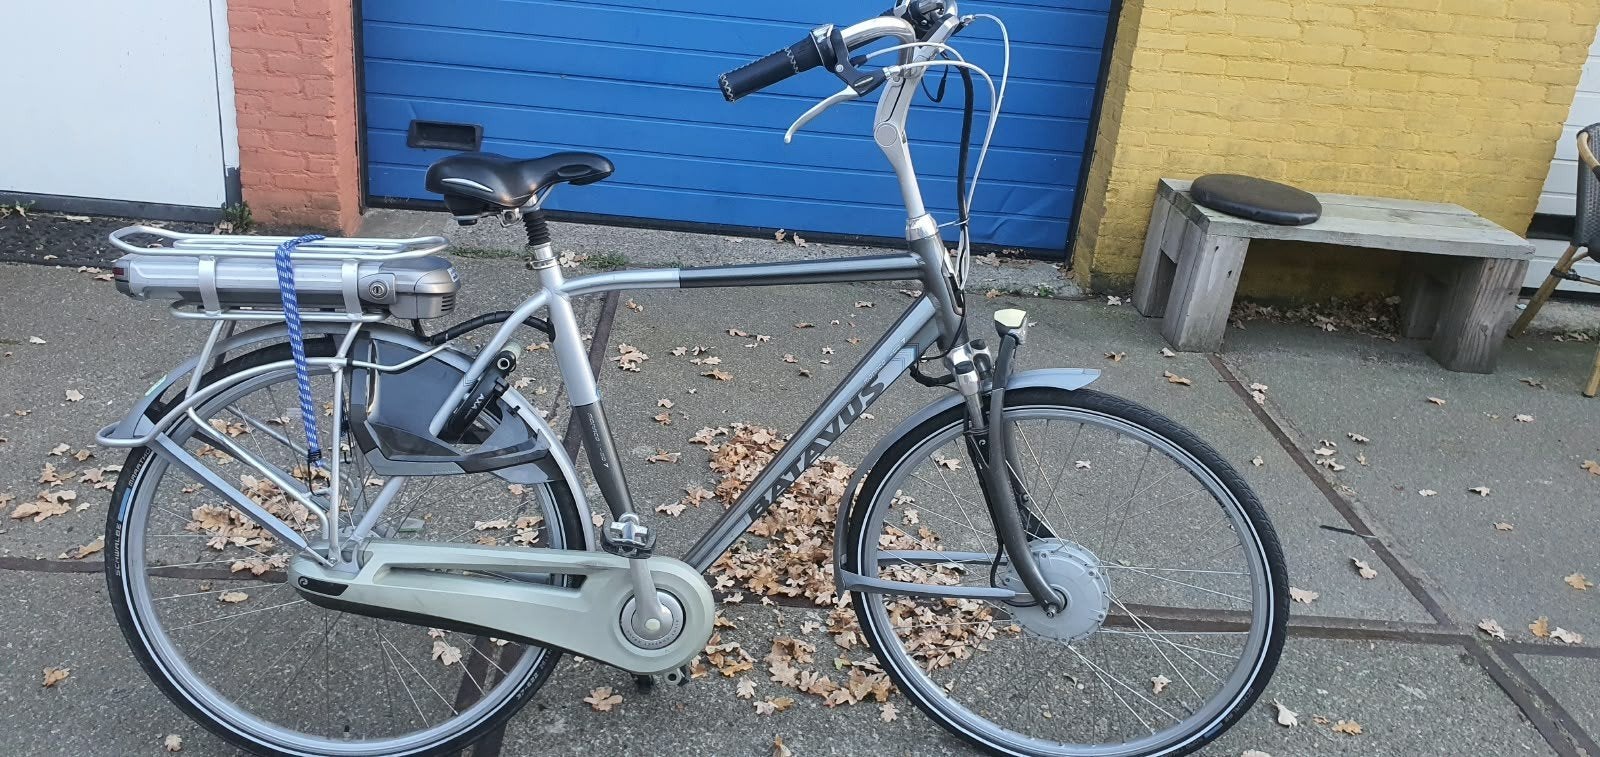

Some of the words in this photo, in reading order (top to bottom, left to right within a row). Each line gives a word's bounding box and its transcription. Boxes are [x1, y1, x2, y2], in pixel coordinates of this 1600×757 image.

[471, 393, 485, 409] AXA
[750, 374, 885, 520] BATAVUS
[112, 522, 122, 577] SCHWALBE
[128, 448, 152, 487] MARATHO
